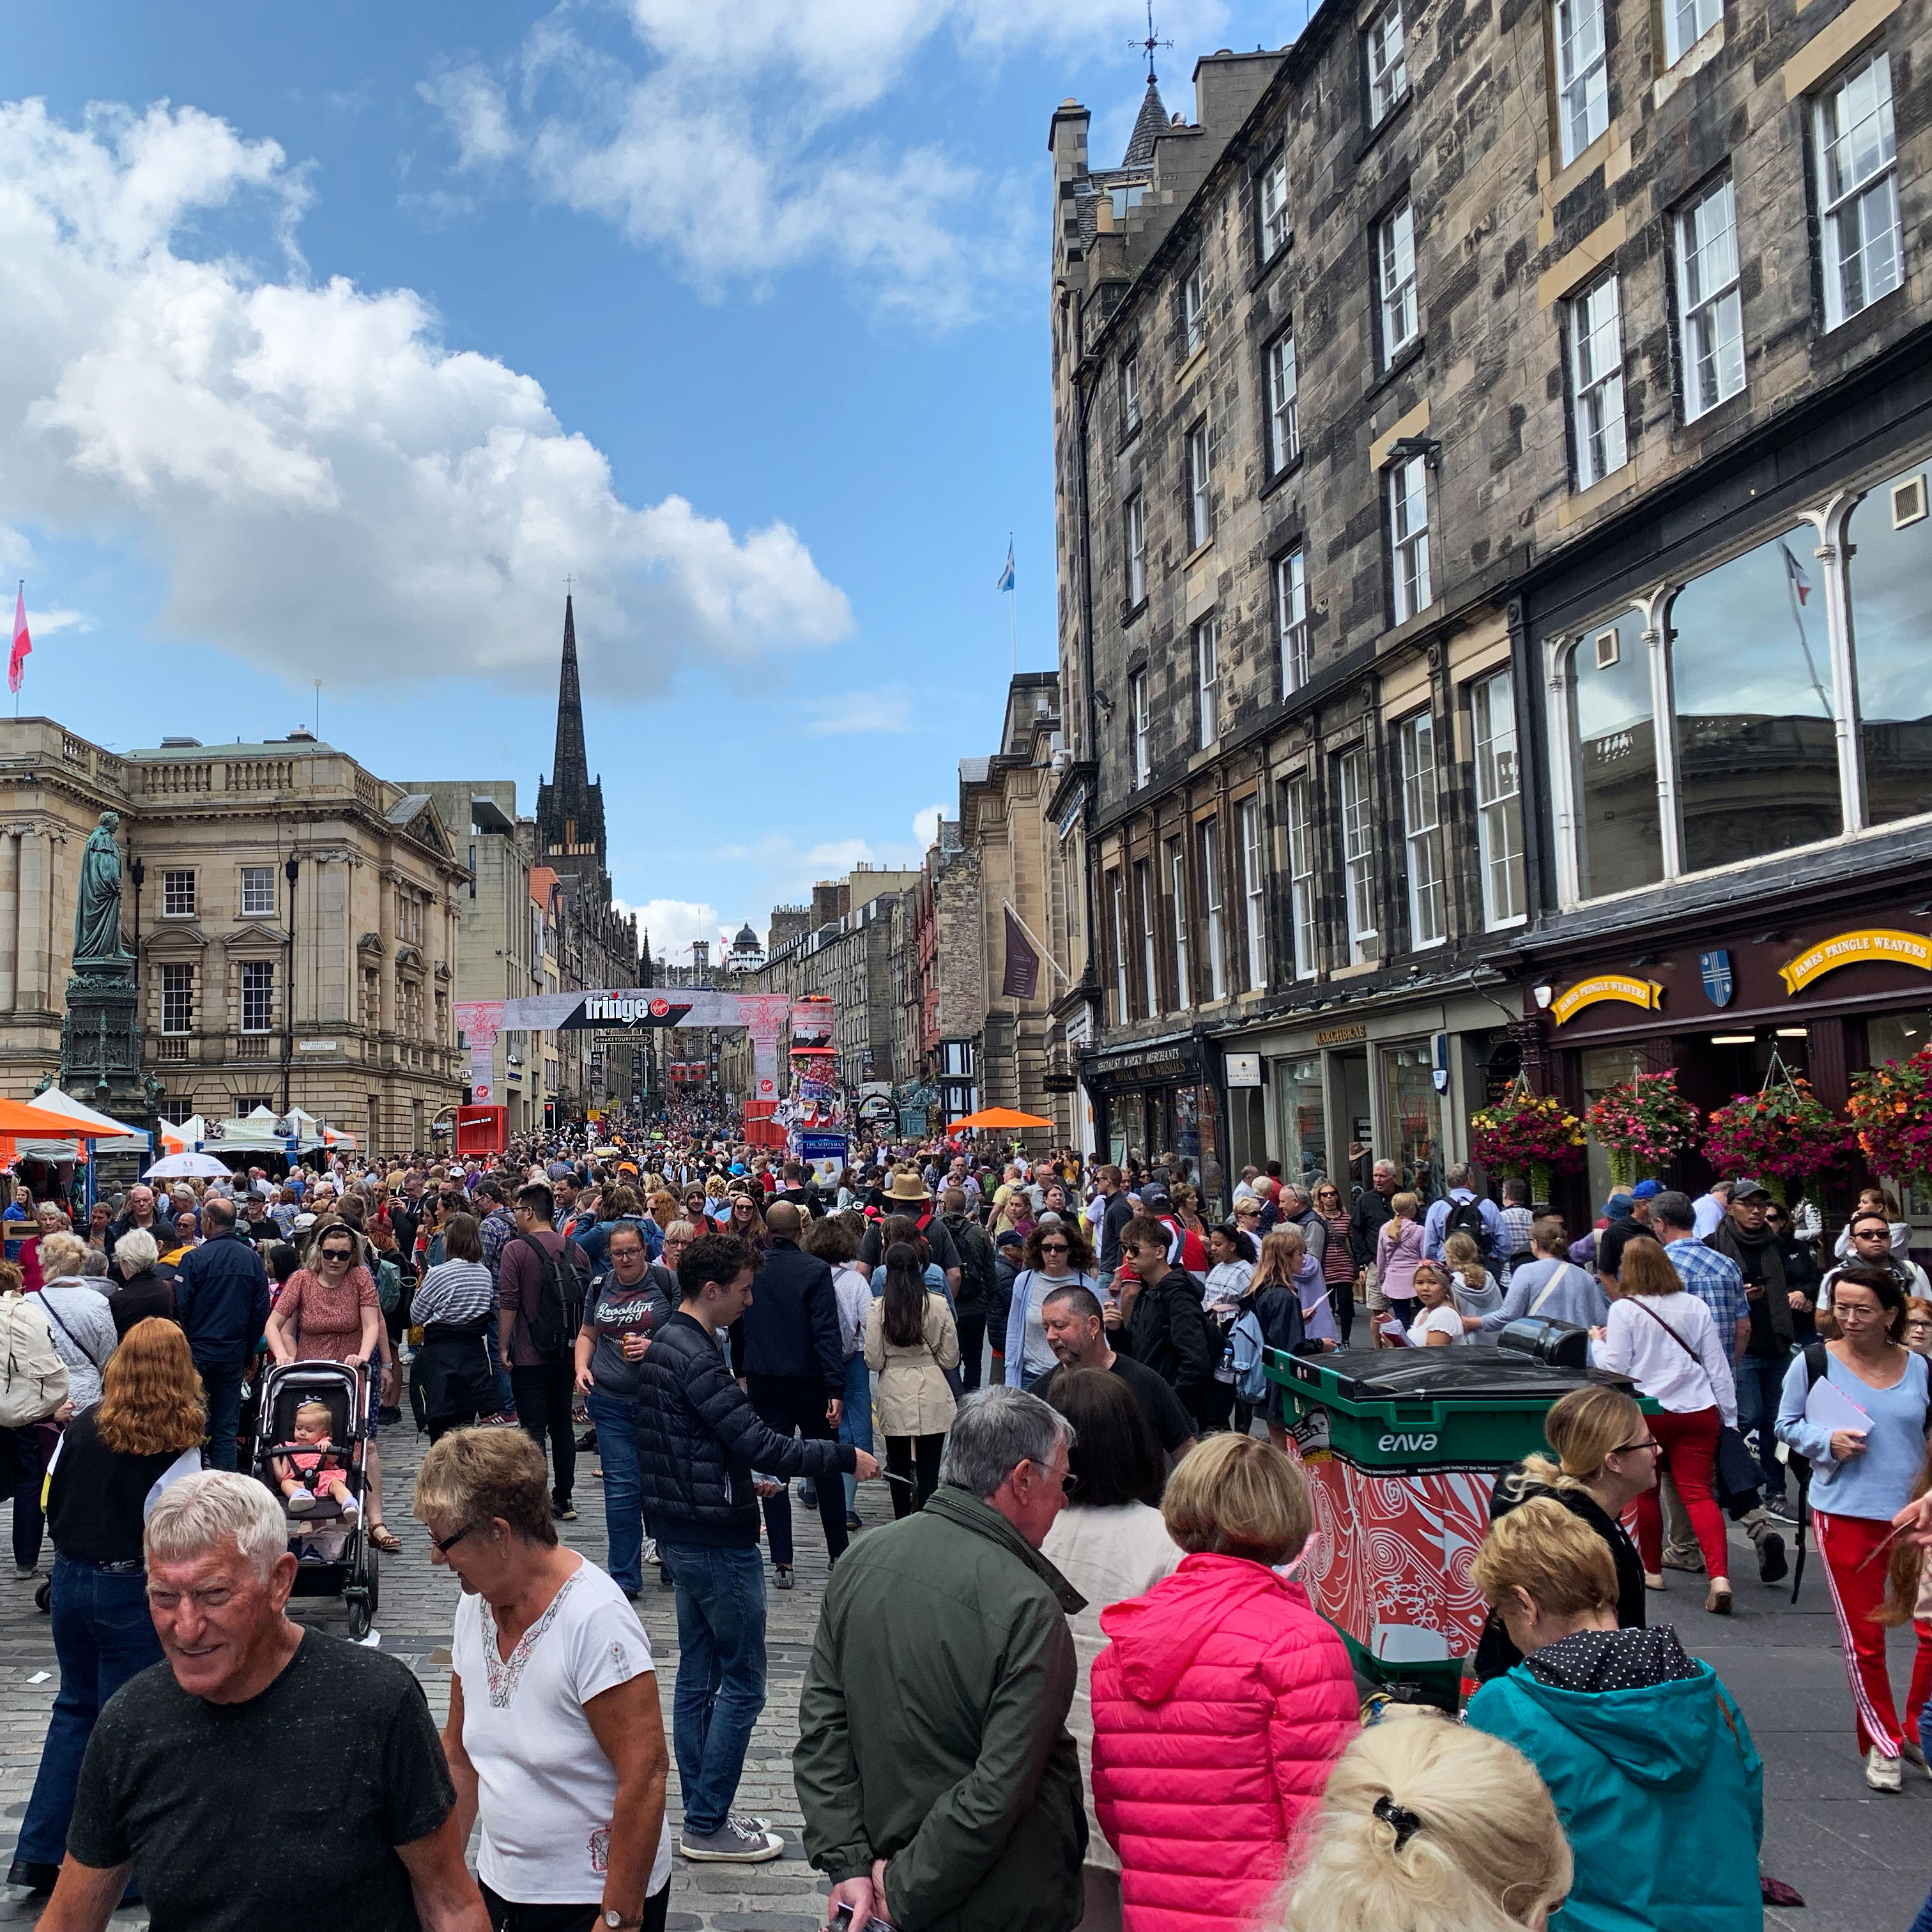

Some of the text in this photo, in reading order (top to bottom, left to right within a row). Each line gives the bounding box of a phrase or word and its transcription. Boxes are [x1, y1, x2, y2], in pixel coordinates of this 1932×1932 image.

[1795, 937, 1927, 979] JAMES PRINGLE WEAVERS
[1560, 981, 1646, 1013] JAMES PRINGLE WEAVERS
[585, 996, 648, 1023] fringe
[652, 1000, 668, 1015] Virgin
[795, 1029, 819, 1040] fringe
[1314, 1025, 1367, 1045] MARCHBRAE
[1146, 1048, 1179, 1063] MERCHANTS
[1115, 1059, 1186, 1082] ROYAL MILE WHISKIES
[596, 1300, 654, 1321] Brooklyn
[617, 1314, 635, 1327] 76
[1378, 1434, 1438, 1452] enva
